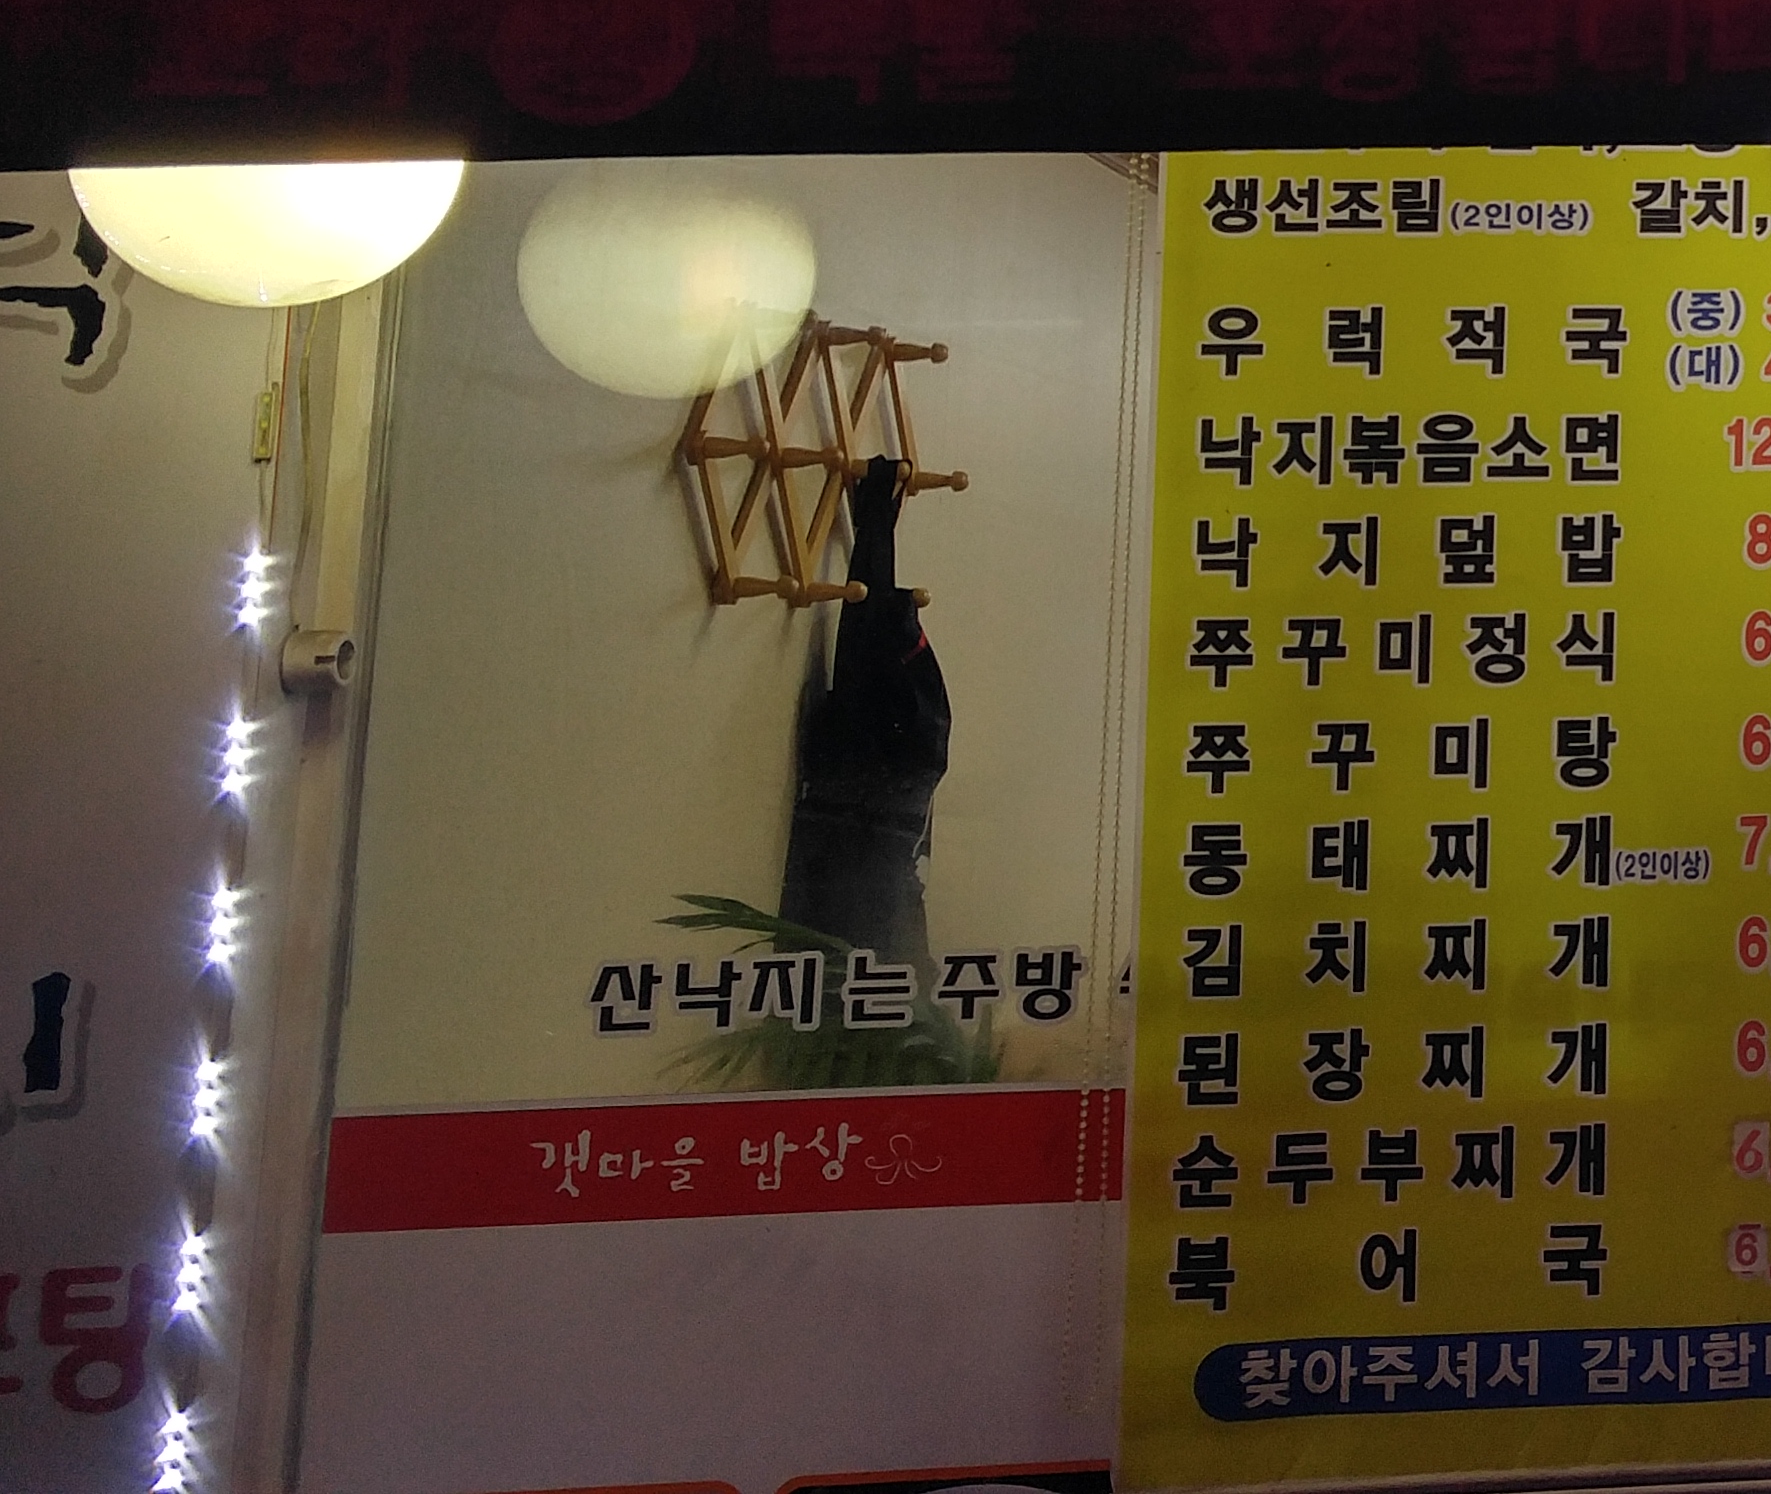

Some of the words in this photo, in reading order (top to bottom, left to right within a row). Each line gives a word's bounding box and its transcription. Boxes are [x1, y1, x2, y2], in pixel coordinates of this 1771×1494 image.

[1669, 289, 1744, 334] (중)
[1669, 343, 1742, 389] (대)
[1198, 413, 1622, 488] 낙지볶음소면
[590, 954, 914, 1033] 산낙지는
[937, 948, 1086, 1024] 주방
[530, 1128, 705, 1198] 갯마을
[739, 1121, 866, 1192] 밥상
[1239, 1339, 1544, 1409] 찾아주셔서
